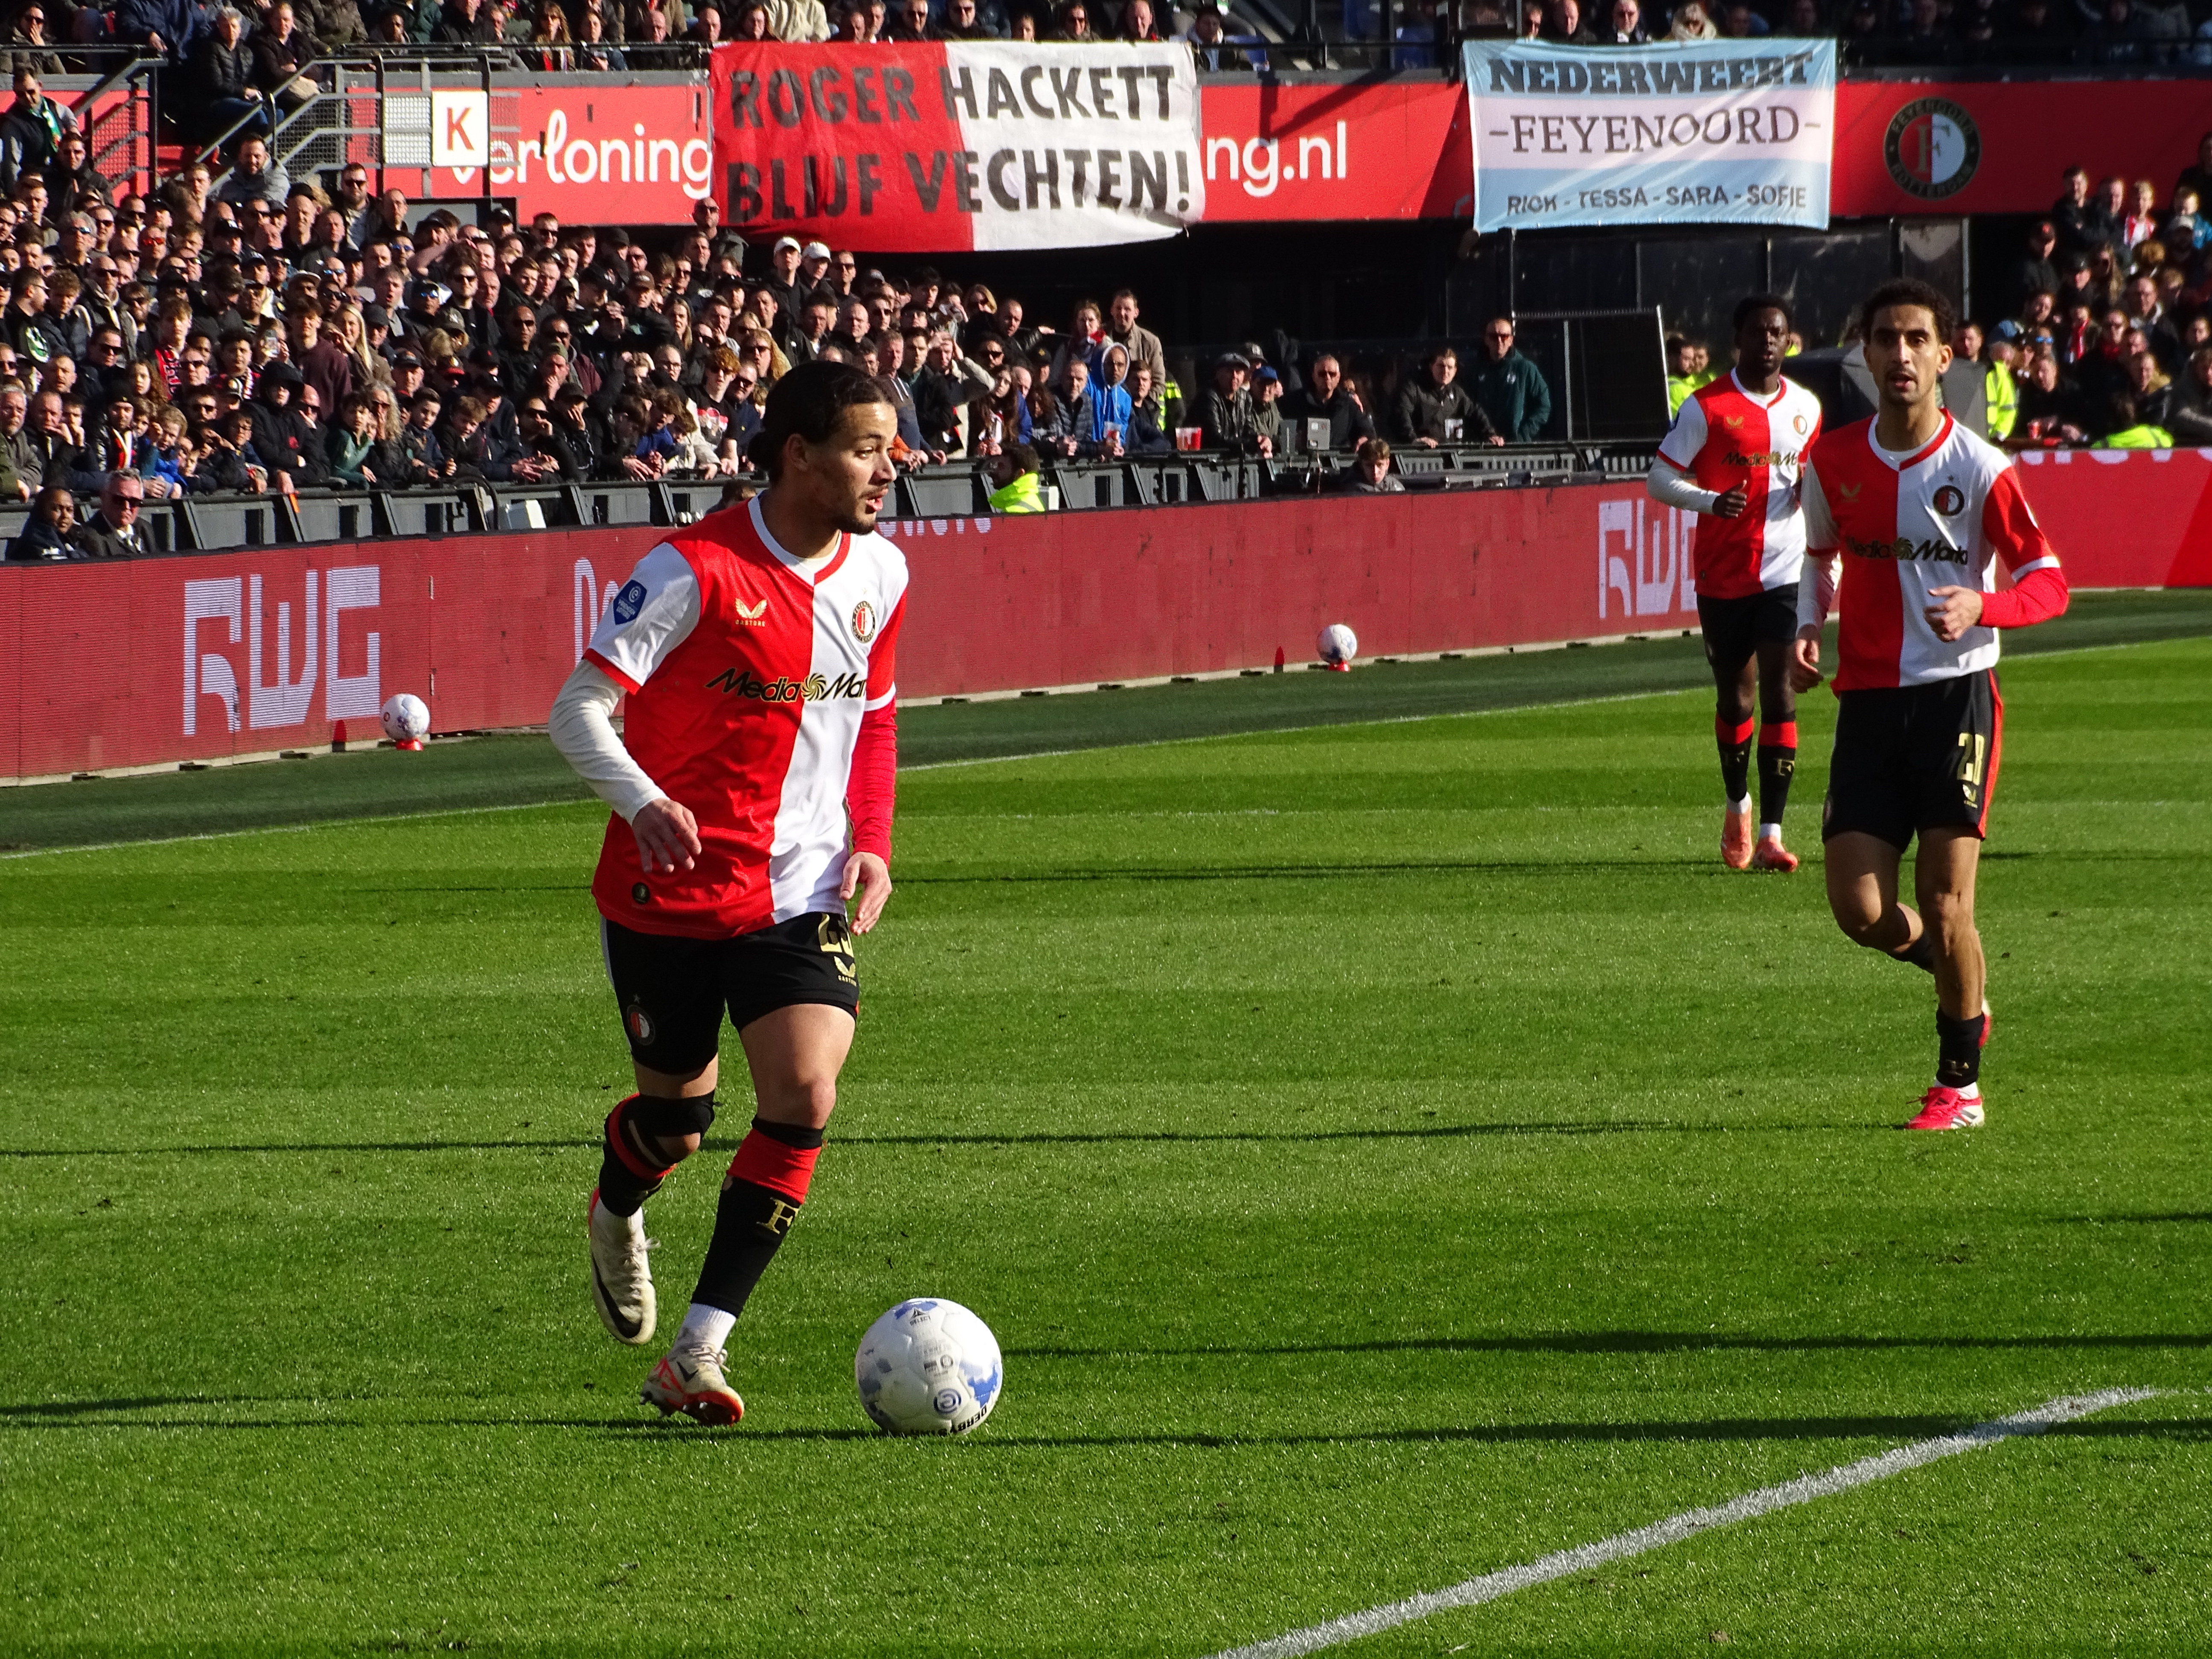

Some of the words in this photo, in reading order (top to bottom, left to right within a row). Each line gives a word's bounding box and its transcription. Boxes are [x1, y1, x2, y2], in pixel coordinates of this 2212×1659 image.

[1487, 52, 1813, 94] NEDERWEERT
[730, 66, 920, 129] ROGER
[941, 64, 1174, 121] HACKETT
[446, 107, 475, 151] K
[726, 153, 883, 223] BLIJF
[903, 148, 1190, 213] VECHTEN!
[1507, 195, 1557, 215] RICK
[1579, 186, 1648, 209] TESSA
[1666, 185, 1729, 206] SARA
[1747, 184, 1806, 209] SOFIE
[183, 565, 380, 737] RWG
[704, 667, 801, 703] Media
[757, 1197, 799, 1234] F
